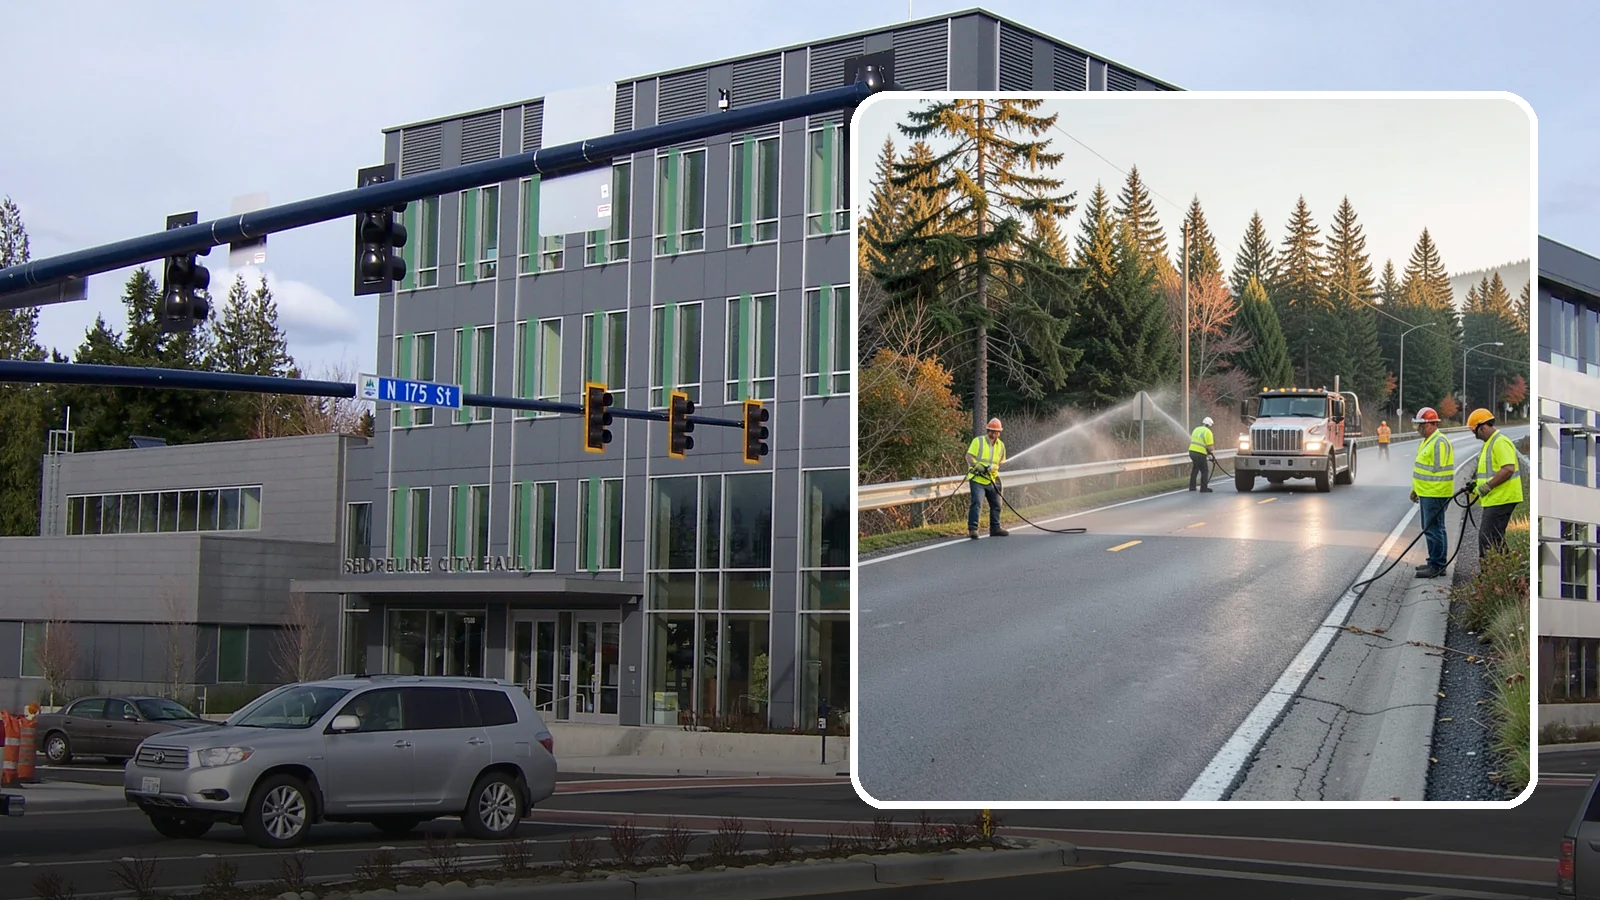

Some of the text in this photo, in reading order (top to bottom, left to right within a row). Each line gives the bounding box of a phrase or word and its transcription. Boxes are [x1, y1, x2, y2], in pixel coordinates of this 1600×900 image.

[387, 380, 451, 406] N 175 St
[344, 556, 525, 574] SHORELINE CITY HALL
